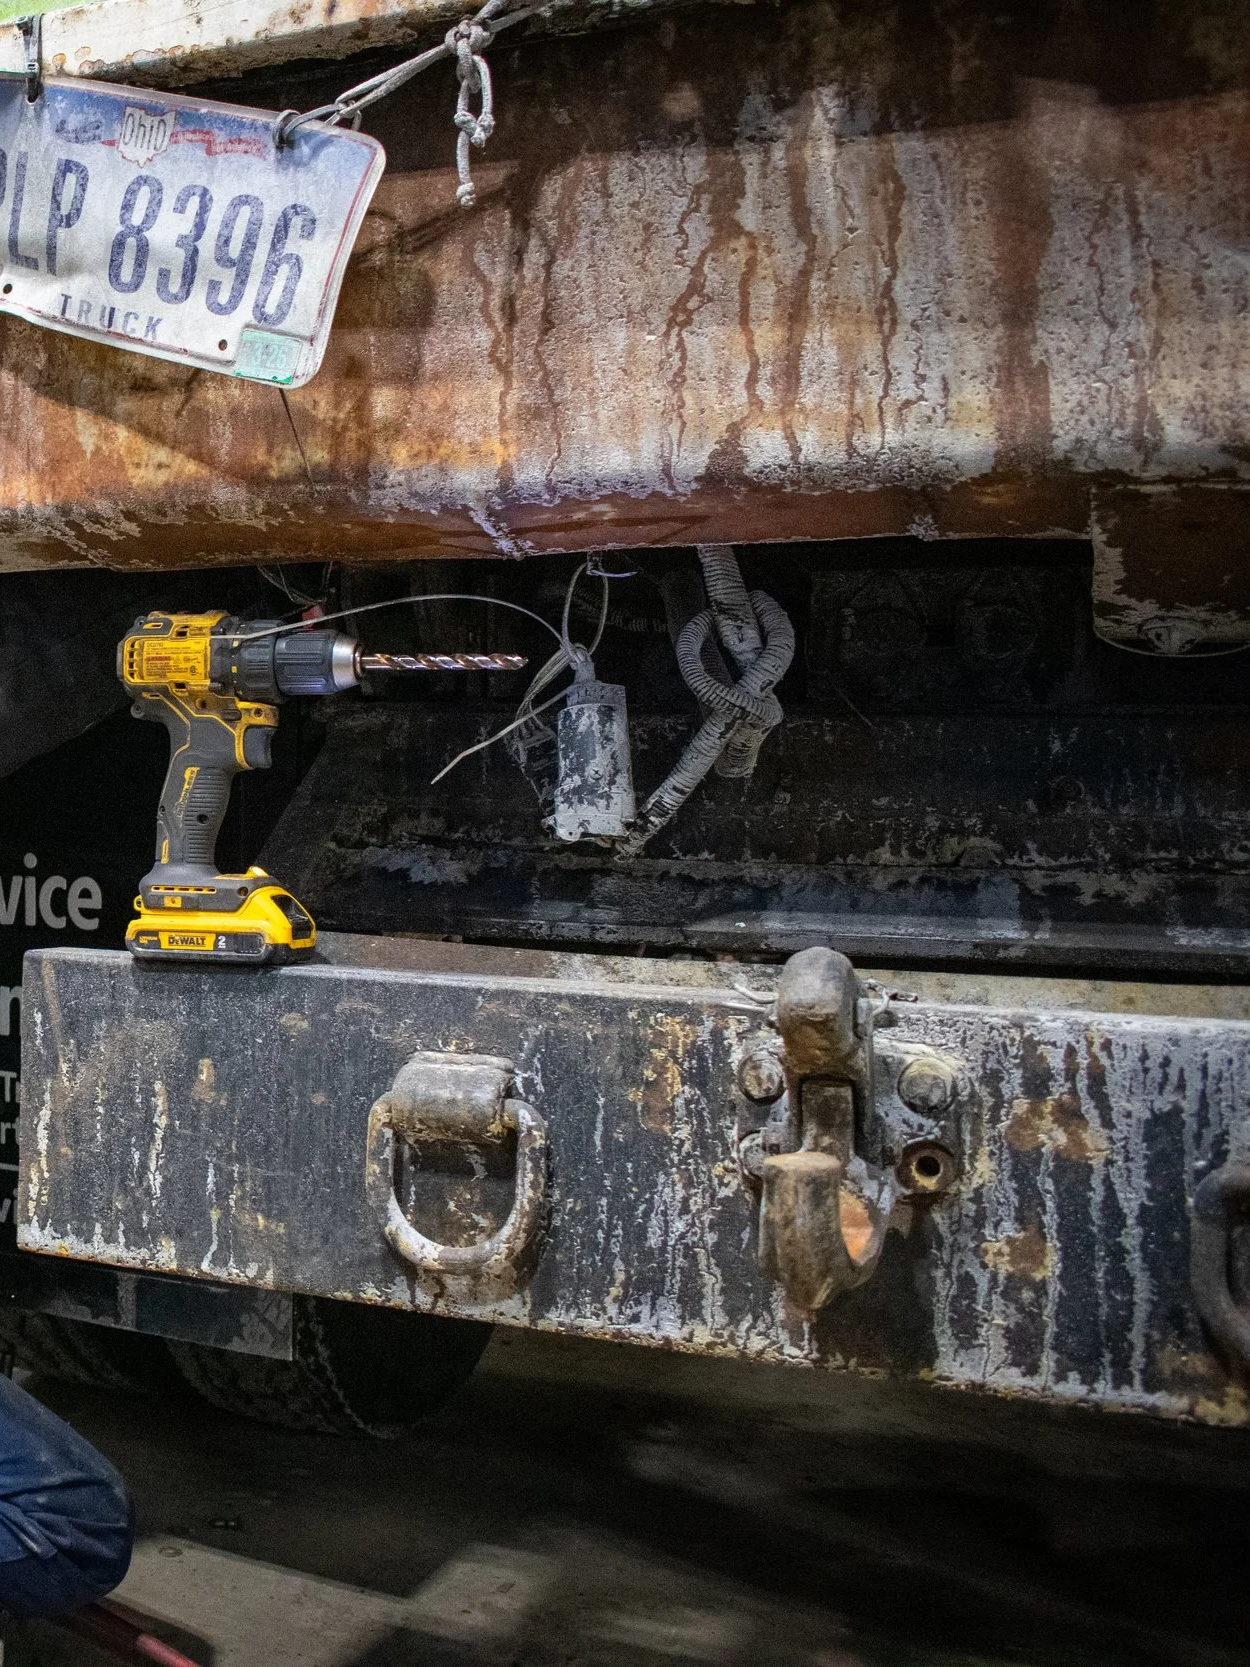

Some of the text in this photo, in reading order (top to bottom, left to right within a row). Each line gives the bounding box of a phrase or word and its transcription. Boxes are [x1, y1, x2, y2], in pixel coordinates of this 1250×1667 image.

[122, 112, 167, 151] Ohio
[108, 174, 317, 327] 8396
[59, 293, 164, 341] TRUCK
